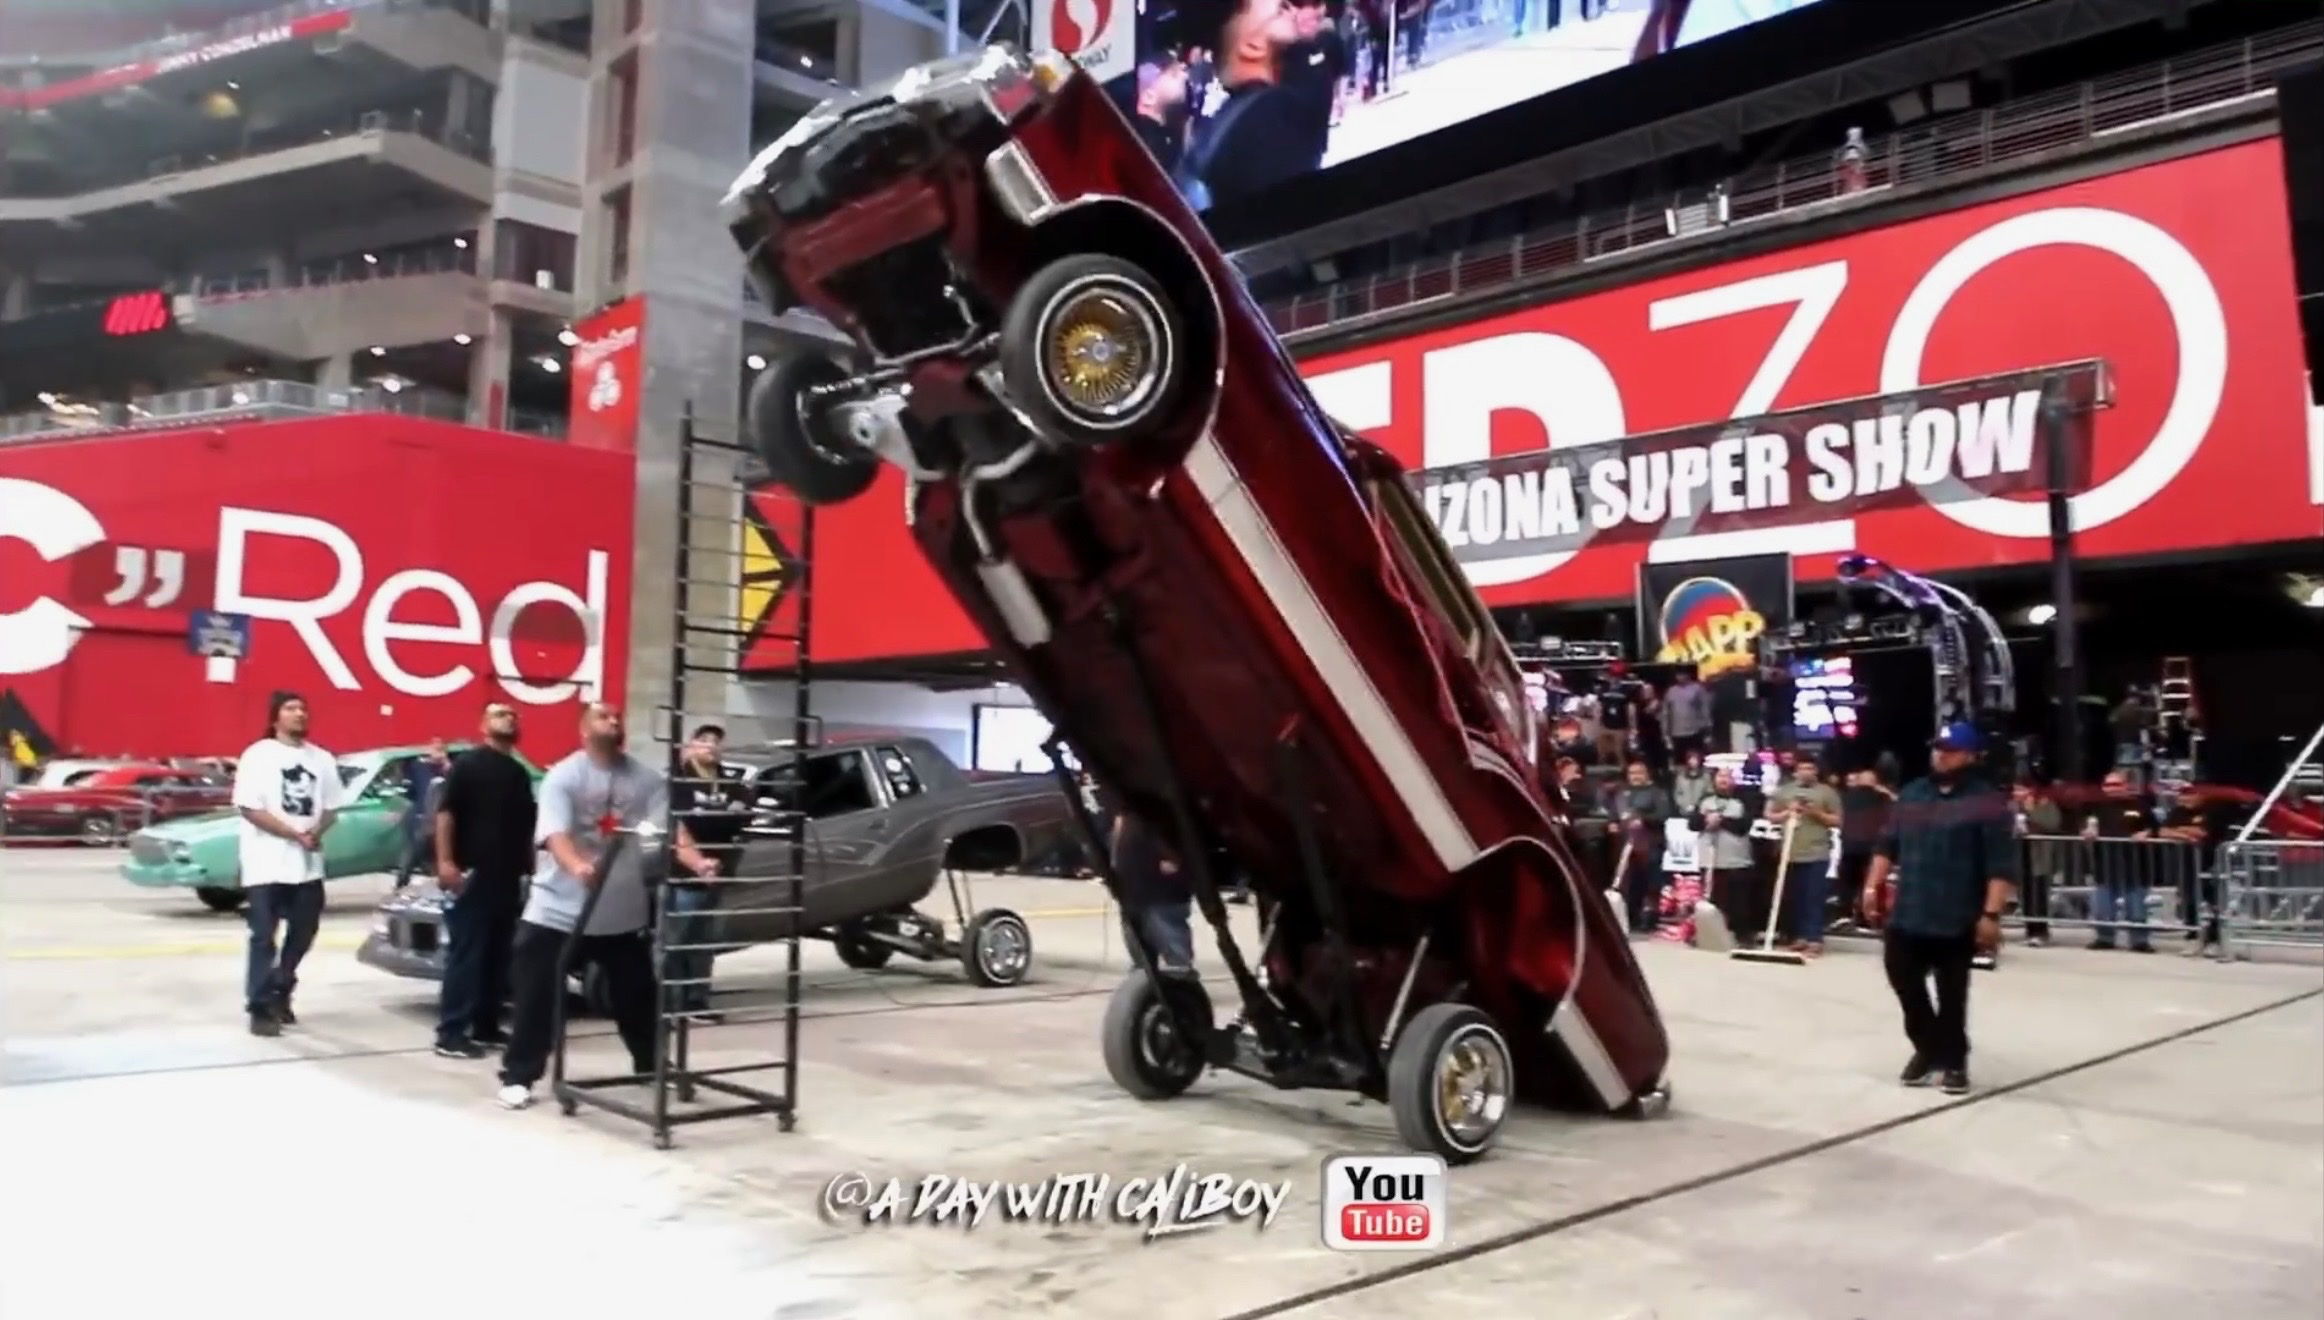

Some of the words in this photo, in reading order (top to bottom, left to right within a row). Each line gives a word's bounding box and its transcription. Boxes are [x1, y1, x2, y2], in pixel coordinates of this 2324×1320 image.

[1418, 466, 1580, 546] IZONA
[1589, 433, 1790, 529] SUPER
[1806, 390, 2041, 502] SHOW
[214, 506, 609, 705] Red
